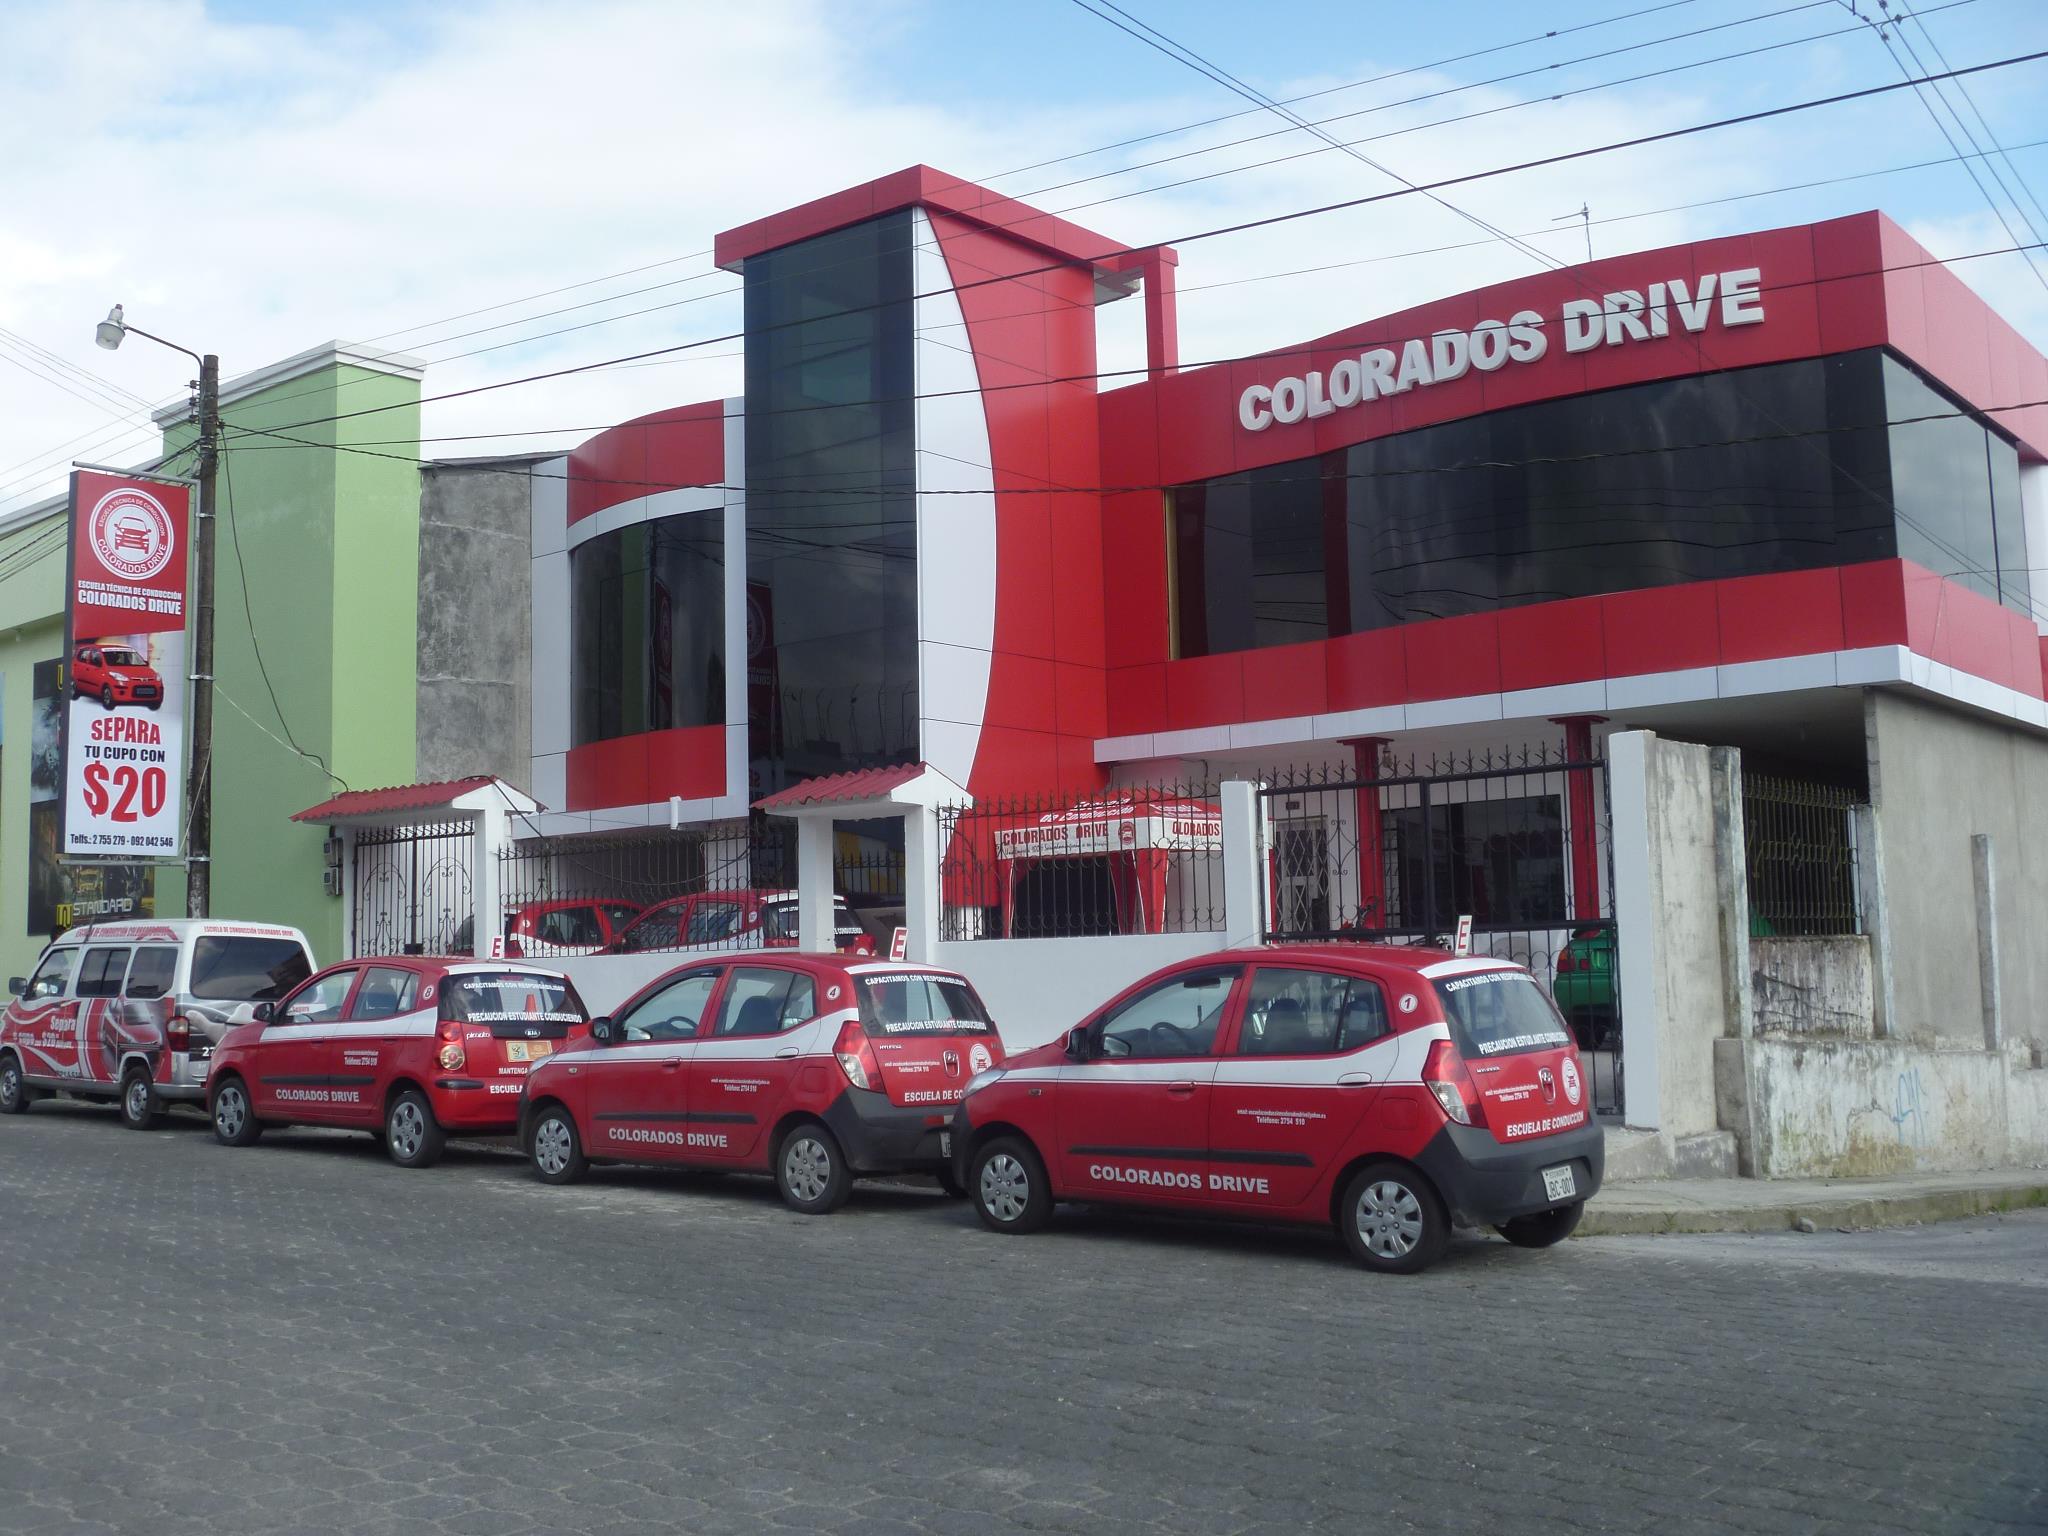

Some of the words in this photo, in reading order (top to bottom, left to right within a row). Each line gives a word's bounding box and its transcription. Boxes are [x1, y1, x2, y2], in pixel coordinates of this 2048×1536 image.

[1239, 310, 1547, 432] COLORADOS
[1563, 267, 1765, 354] DRIVE
[98, 538, 148, 573] COLORADOS
[147, 543, 167, 569] DRIVE
[78, 580, 106, 591] ESCUELA
[133, 587, 142, 596] DE
[78, 589, 147, 611] COLORADOS
[147, 598, 182, 615] DRIVE
[91, 716, 161, 745] SEPARA
[85, 745, 100, 758] TU
[103, 746, 137, 760] CUPO
[140, 749, 165, 762] CON
[83, 760, 166, 823] $20
[93, 834, 98, 844] 2
[98, 834, 111, 845] 755
[113, 835, 126, 846] 279
[1003, 826, 1069, 846] COLORADOS
[1076, 822, 1109, 839] DRIVE
[893, 930, 907, 957] E
[1458, 921, 1469, 949] E
[491, 937, 502, 957] E
[463, 982, 504, 990] CAPACITAMOS
[865, 975, 909, 986] CAPACITAMOS
[1445, 975, 1489, 992] CAPACITAMOS
[1488, 973, 1501, 983] CON
[467, 1012, 508, 1022] PRECAUCION
[509, 1012, 544, 1022] ESTUDIANTE
[544, 1012, 583, 1023] CONDUCIENDO
[885, 1020, 924, 1033] PRECAUCION
[924, 1020, 957, 1029] ESTUDIANTE
[1478, 1036, 1518, 1055] PRECAUCION
[498, 1067, 528, 1075] MANTENGA
[275, 1088, 329, 1101] COLORADOS
[331, 1091, 360, 1102] DRIVE
[904, 1091, 940, 1102] ESCUELA
[942, 1090, 952, 1100] DE
[1280, 1117, 1293, 1125] 2754
[1295, 1118, 1306, 1126] 510
[1507, 1121, 1541, 1137] ESCUELA
[1542, 1120, 1551, 1131] DE
[1552, 1111, 1584, 1129] CONDUCCION
[609, 1128, 684, 1144] COLORADOS
[687, 1133, 728, 1147] DRIVE
[1090, 1165, 1202, 1189] COLORADOS
[1209, 1174, 1269, 1194] DRIVE
